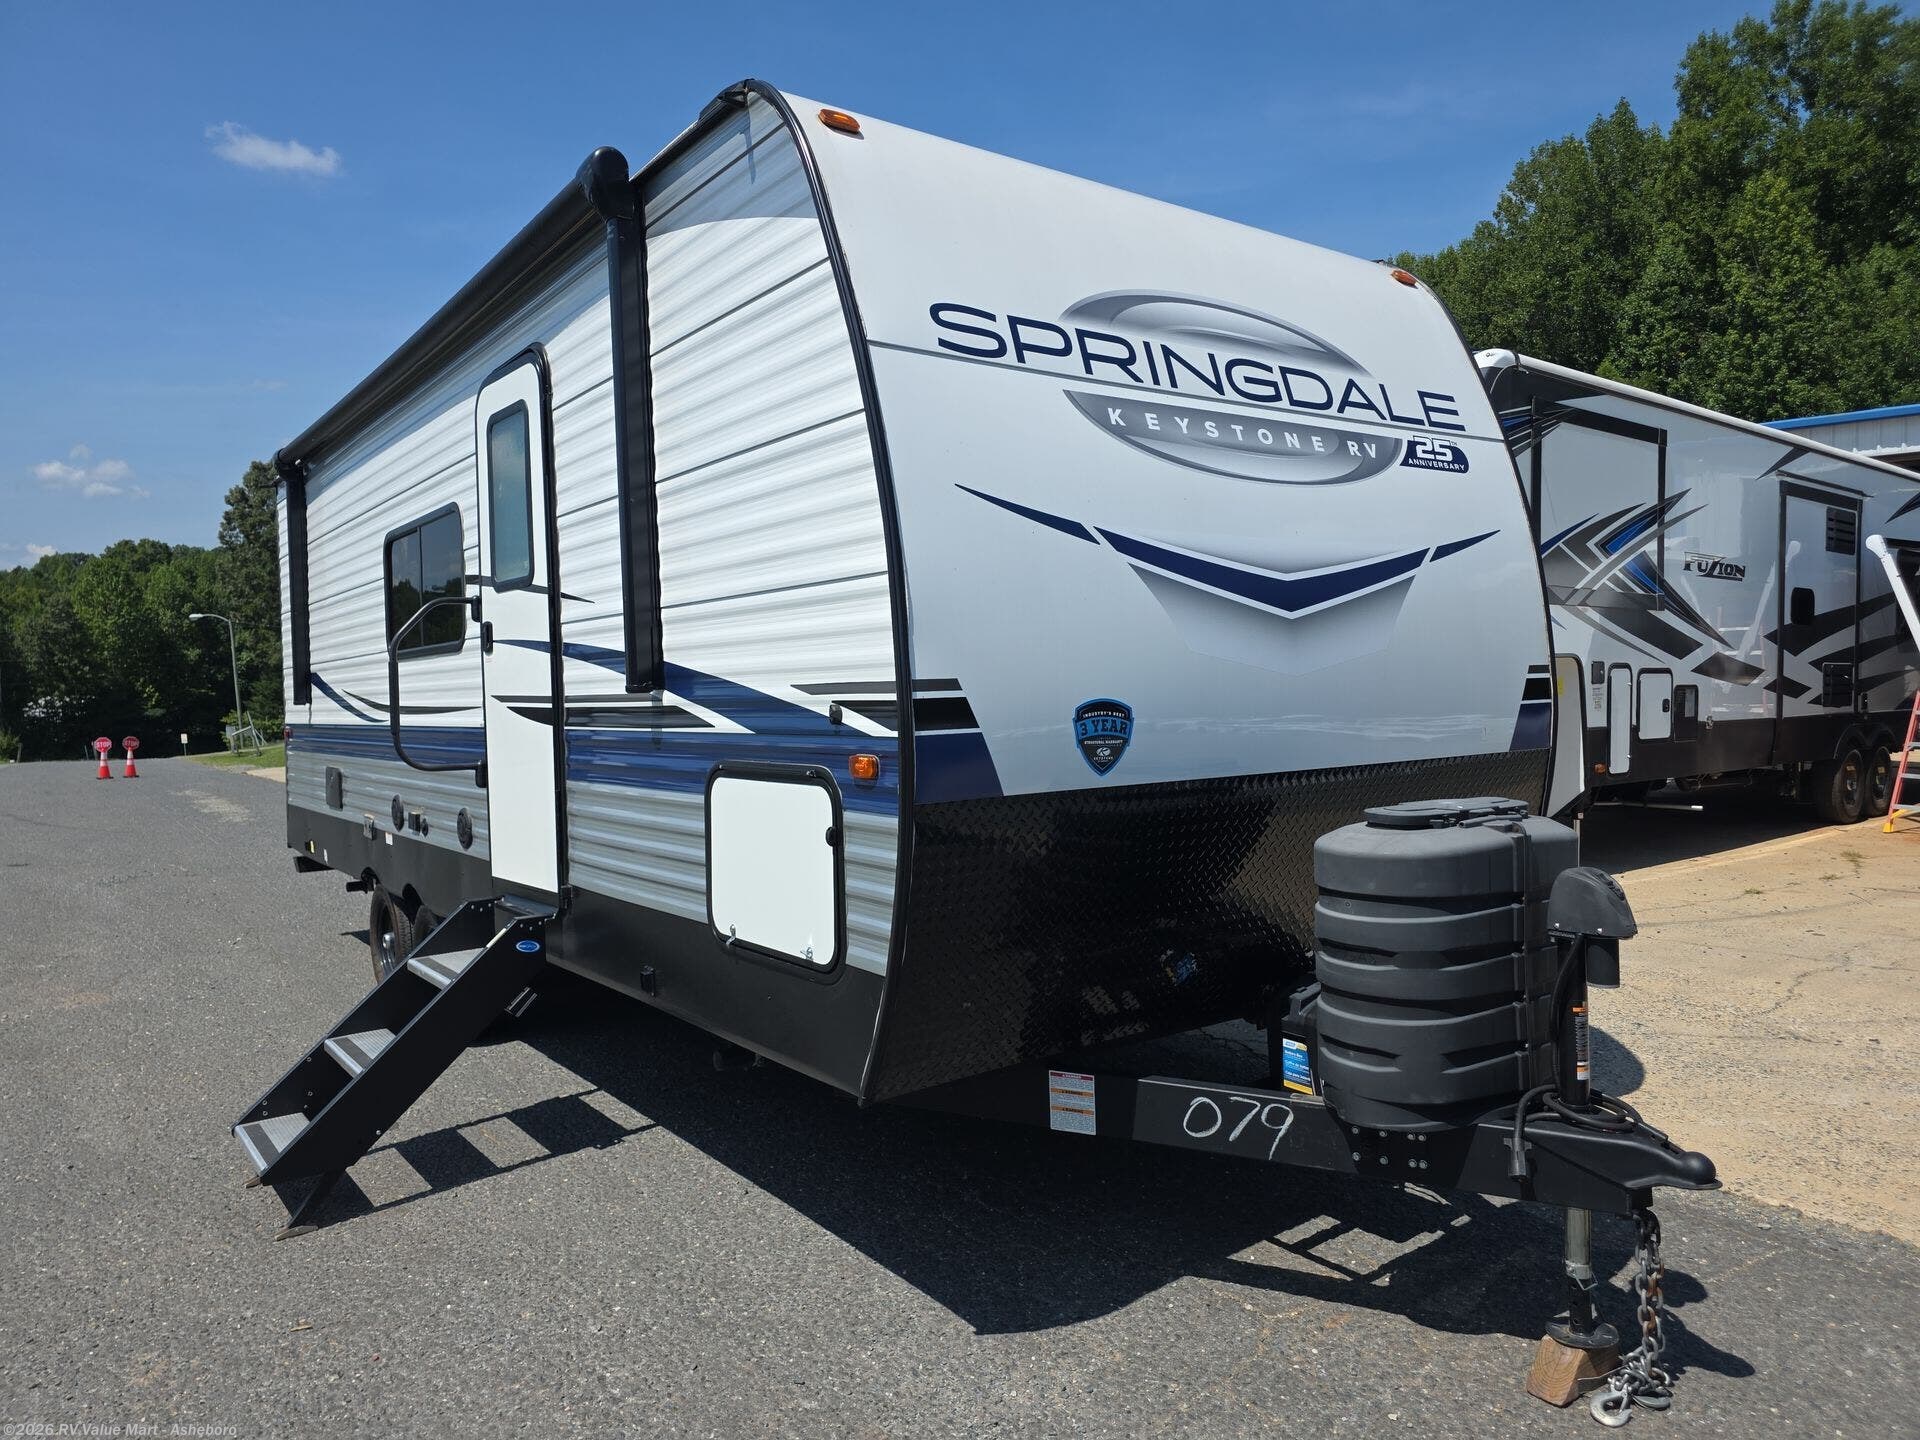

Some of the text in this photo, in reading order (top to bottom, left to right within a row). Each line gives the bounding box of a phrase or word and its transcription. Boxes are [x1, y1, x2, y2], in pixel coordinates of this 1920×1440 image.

[929, 303, 1466, 431] SPRINGDALE
[1107, 408, 1378, 459] KEYSTONE RV
[1408, 457, 1465, 470] ANNIVERSARY
[1683, 552, 1746, 581] FUZION
[1080, 718, 1128, 737] 3 YEAR
[1183, 1096, 1295, 1160] 079
